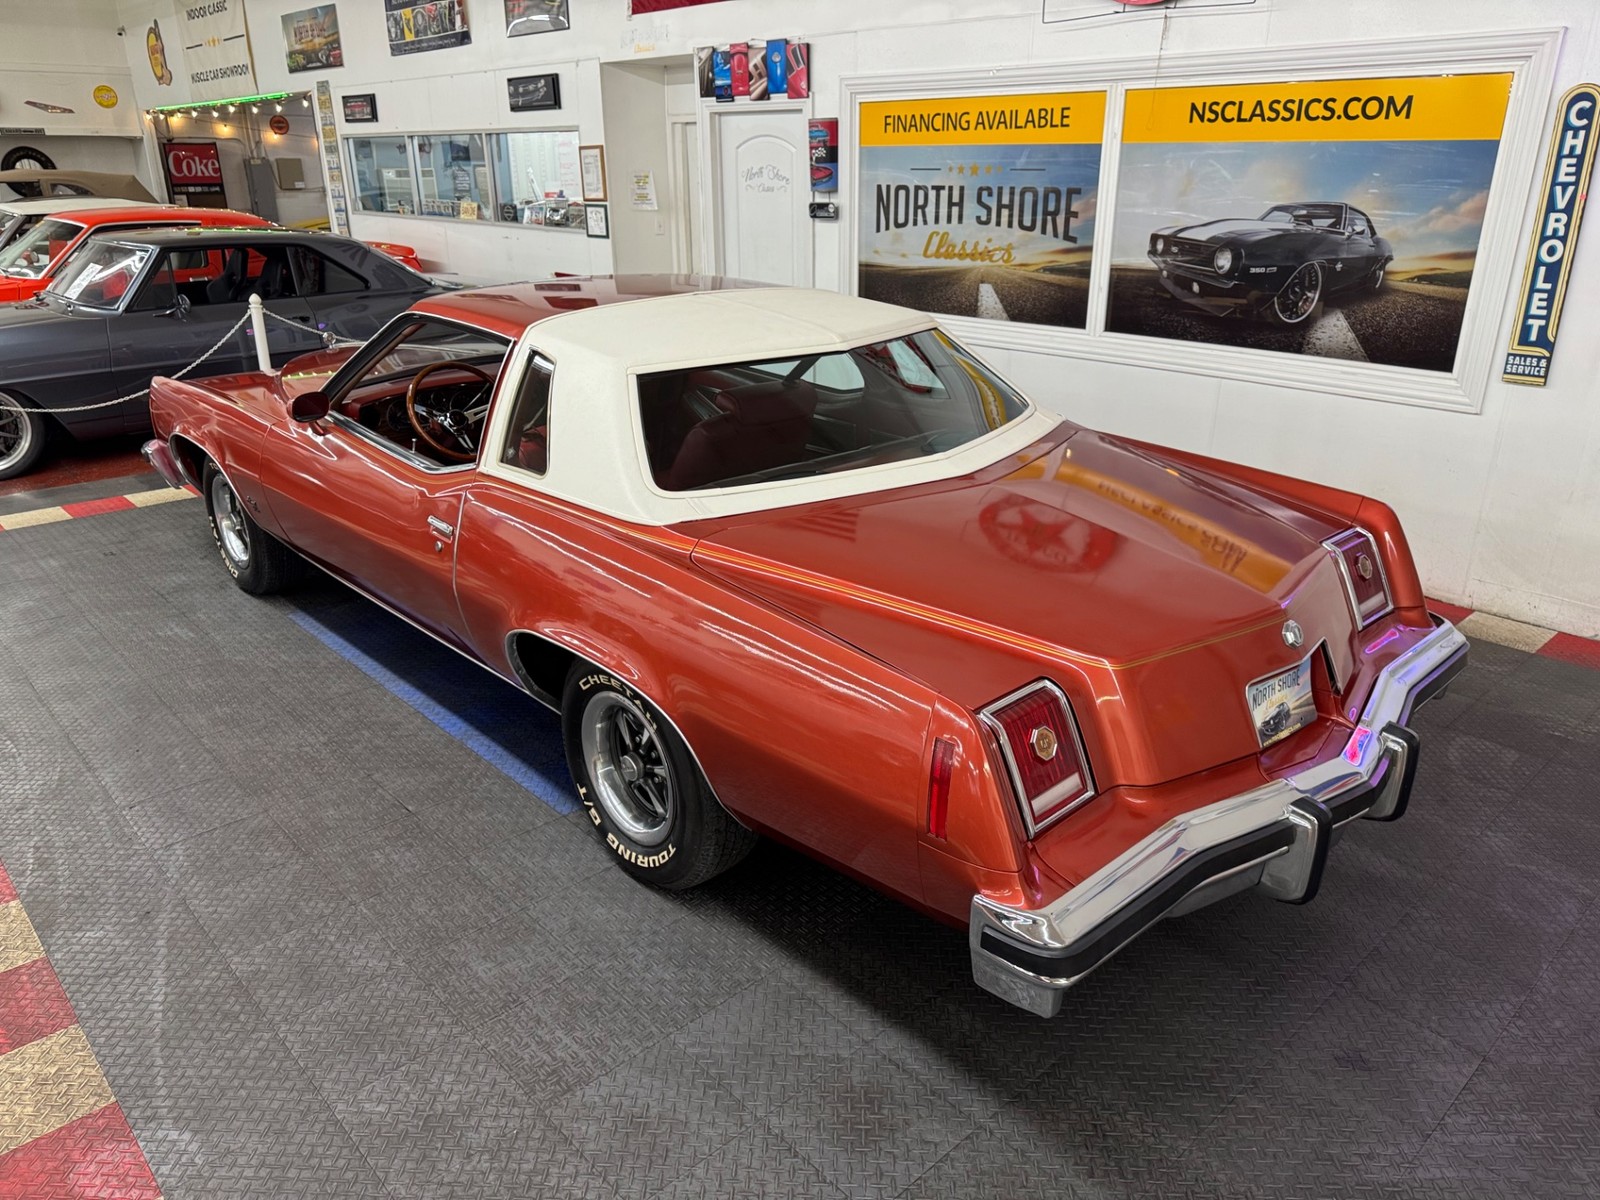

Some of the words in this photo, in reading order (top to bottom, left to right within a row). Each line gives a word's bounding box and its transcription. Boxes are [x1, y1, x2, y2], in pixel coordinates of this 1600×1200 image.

[186, 7, 207, 21] INDOOR
[207, 0, 228, 16] CLASSIC
[191, 70, 210, 84] MUSCLE
[210, 69, 219, 81] CAR
[219, 62, 250, 79] SHOWROOM
[884, 111, 971, 134] FINANCING
[974, 106, 1071, 131] AVAILABLE
[1188, 94, 1415, 124] NSCLASSICS.COM
[168, 151, 220, 177] Coke
[876, 184, 965, 234] NORTH
[975, 185, 1082, 244] SHORE
[1527, 100, 1593, 342] CHEVROLET
[922, 231, 1016, 264] Classics
[1506, 364, 1546, 377] SERVICE
[1508, 355, 1538, 367] SALES
[1539, 358, 1548, 368] &
[1252, 681, 1276, 711] NORTH
[1277, 668, 1300, 692] SHORE
[606, 832, 676, 868] TOURING
